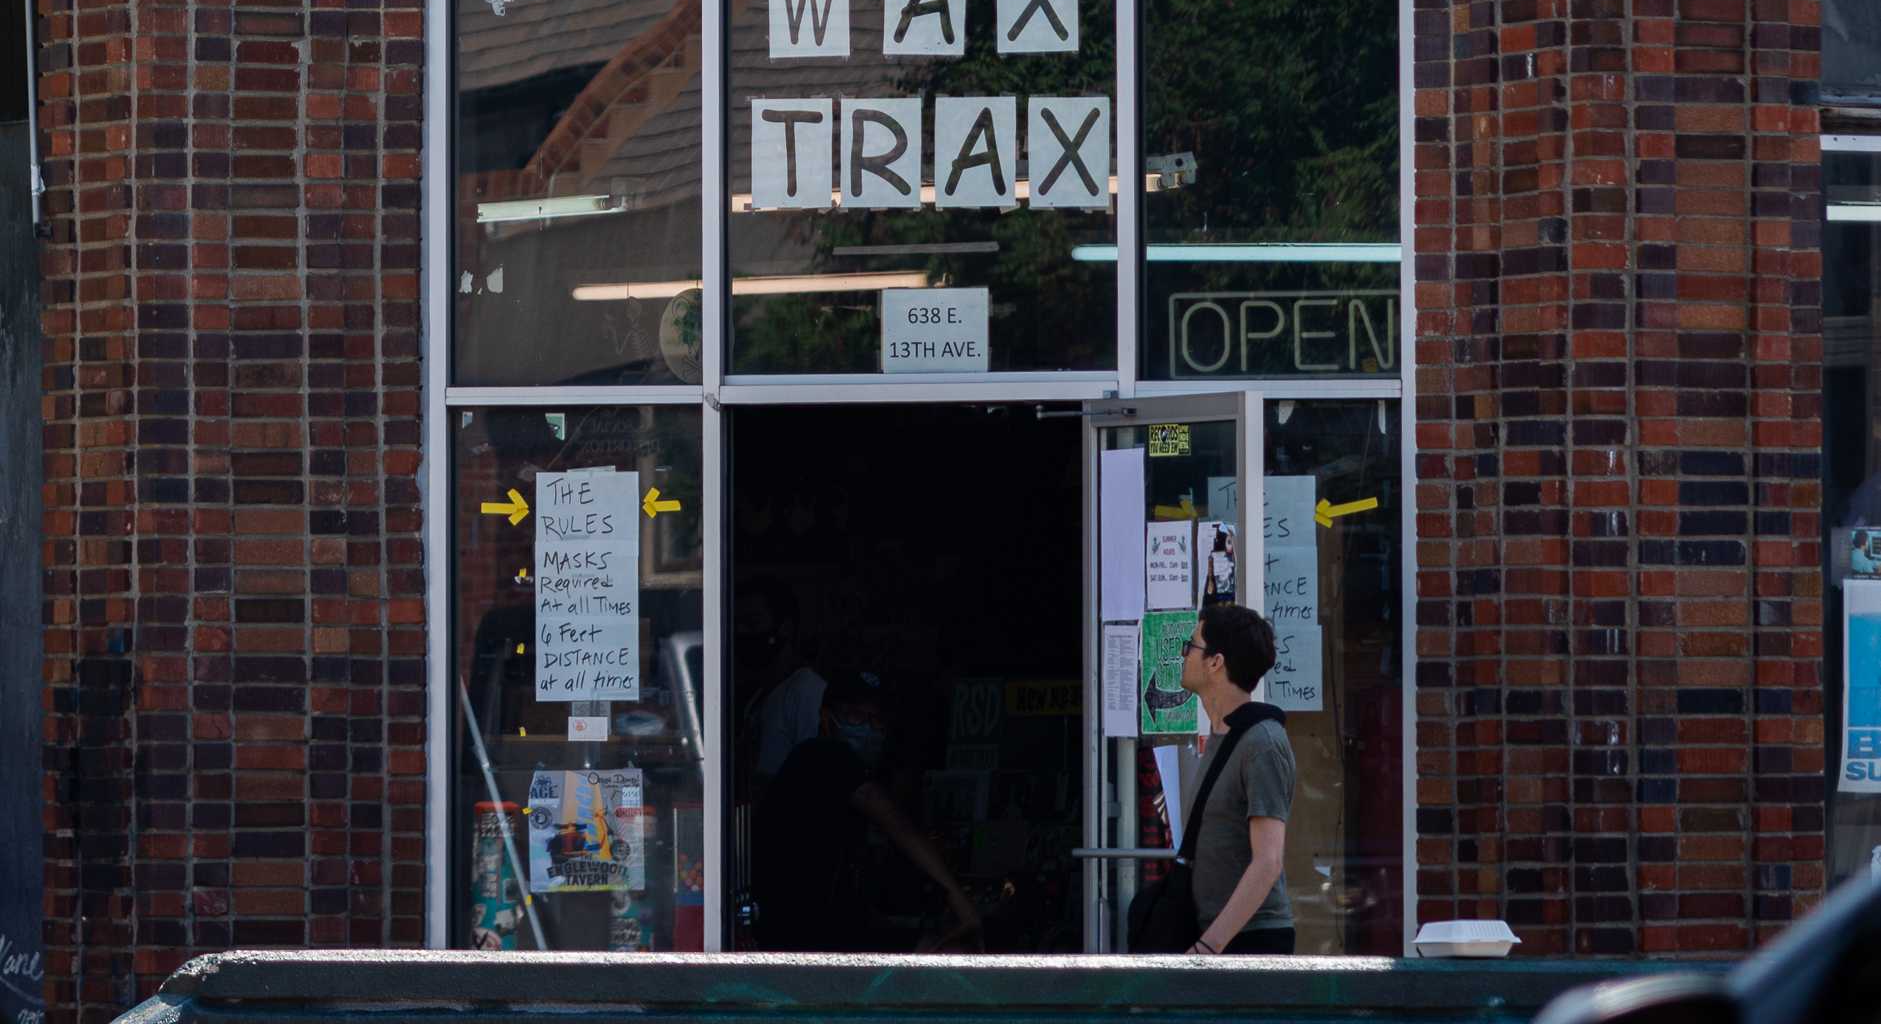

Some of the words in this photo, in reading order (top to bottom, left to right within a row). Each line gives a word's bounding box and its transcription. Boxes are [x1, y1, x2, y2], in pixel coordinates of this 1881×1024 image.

[761, 106, 1101, 197] TRAX
[907, 307, 940, 326] 638
[946, 307, 963, 326] E.
[1181, 298, 1396, 372] OPEN
[889, 341, 936, 360] 13TH
[940, 341, 982, 360] AVE.
[546, 478, 594, 505] THE
[541, 513, 614, 540] RULES
[543, 551, 612, 574] MASKS
[541, 575, 613, 598] Required
[567, 595, 589, 615] all
[541, 624, 552, 644] 6
[543, 648, 629, 668] DISTANCE
[540, 673, 557, 691] at
[565, 670, 586, 692] all
[594, 670, 633, 692] times
[567, 873, 609, 887] TAVERN
